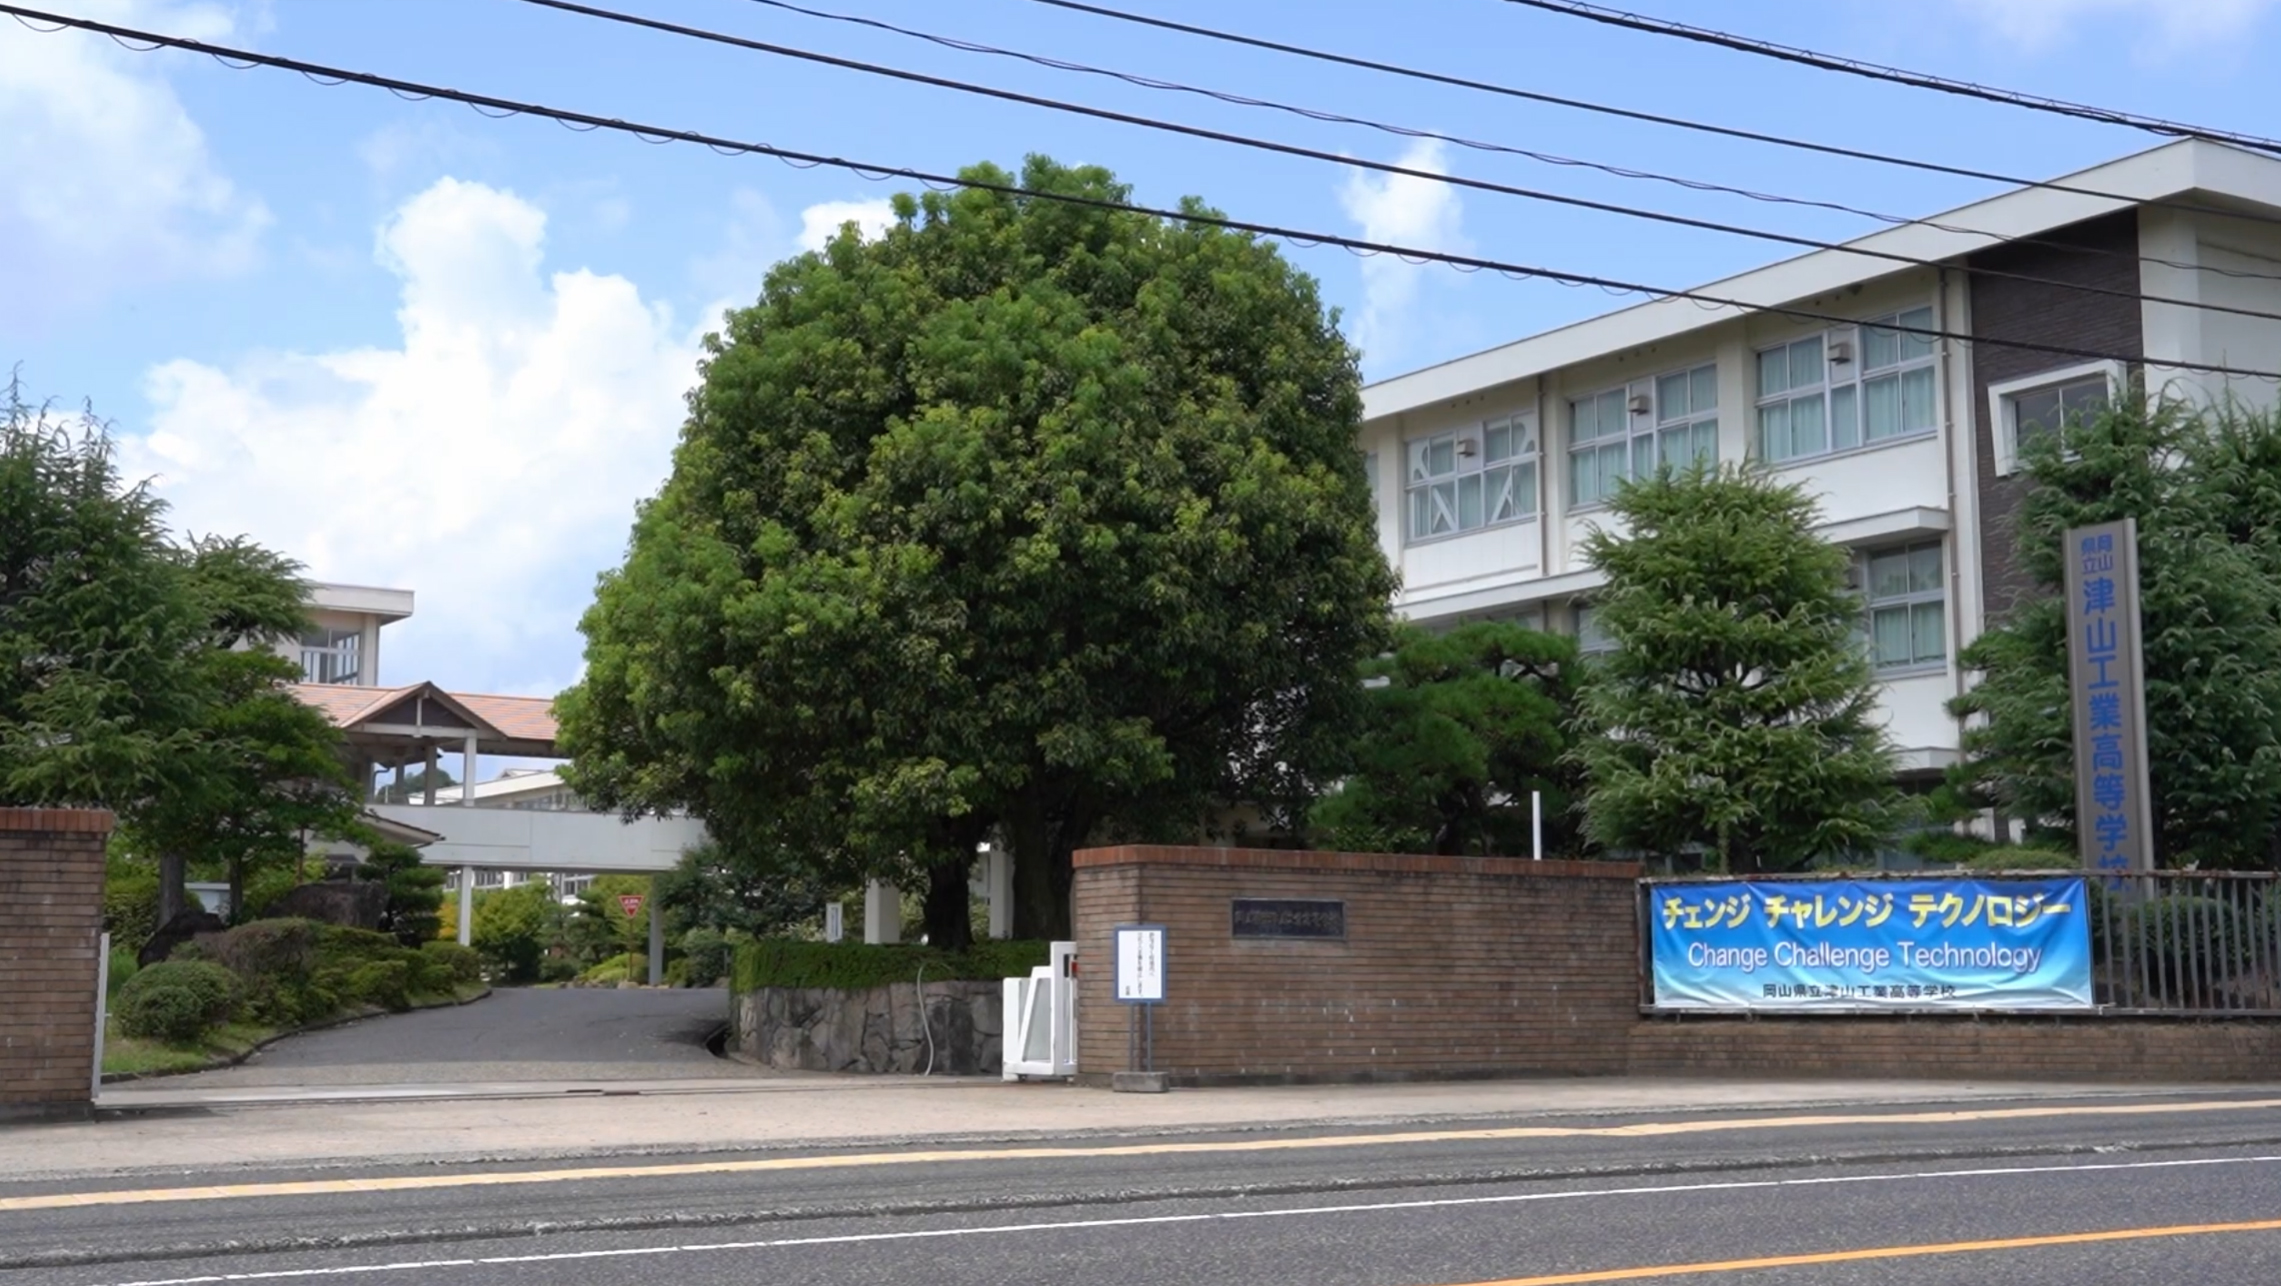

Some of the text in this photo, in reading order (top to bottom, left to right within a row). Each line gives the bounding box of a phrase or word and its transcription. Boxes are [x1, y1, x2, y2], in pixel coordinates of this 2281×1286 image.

[1663, 892, 2071, 929] チェンジ チャレンジ テクノロジー
[1688, 941, 2042, 973] Change Challenge Technology
